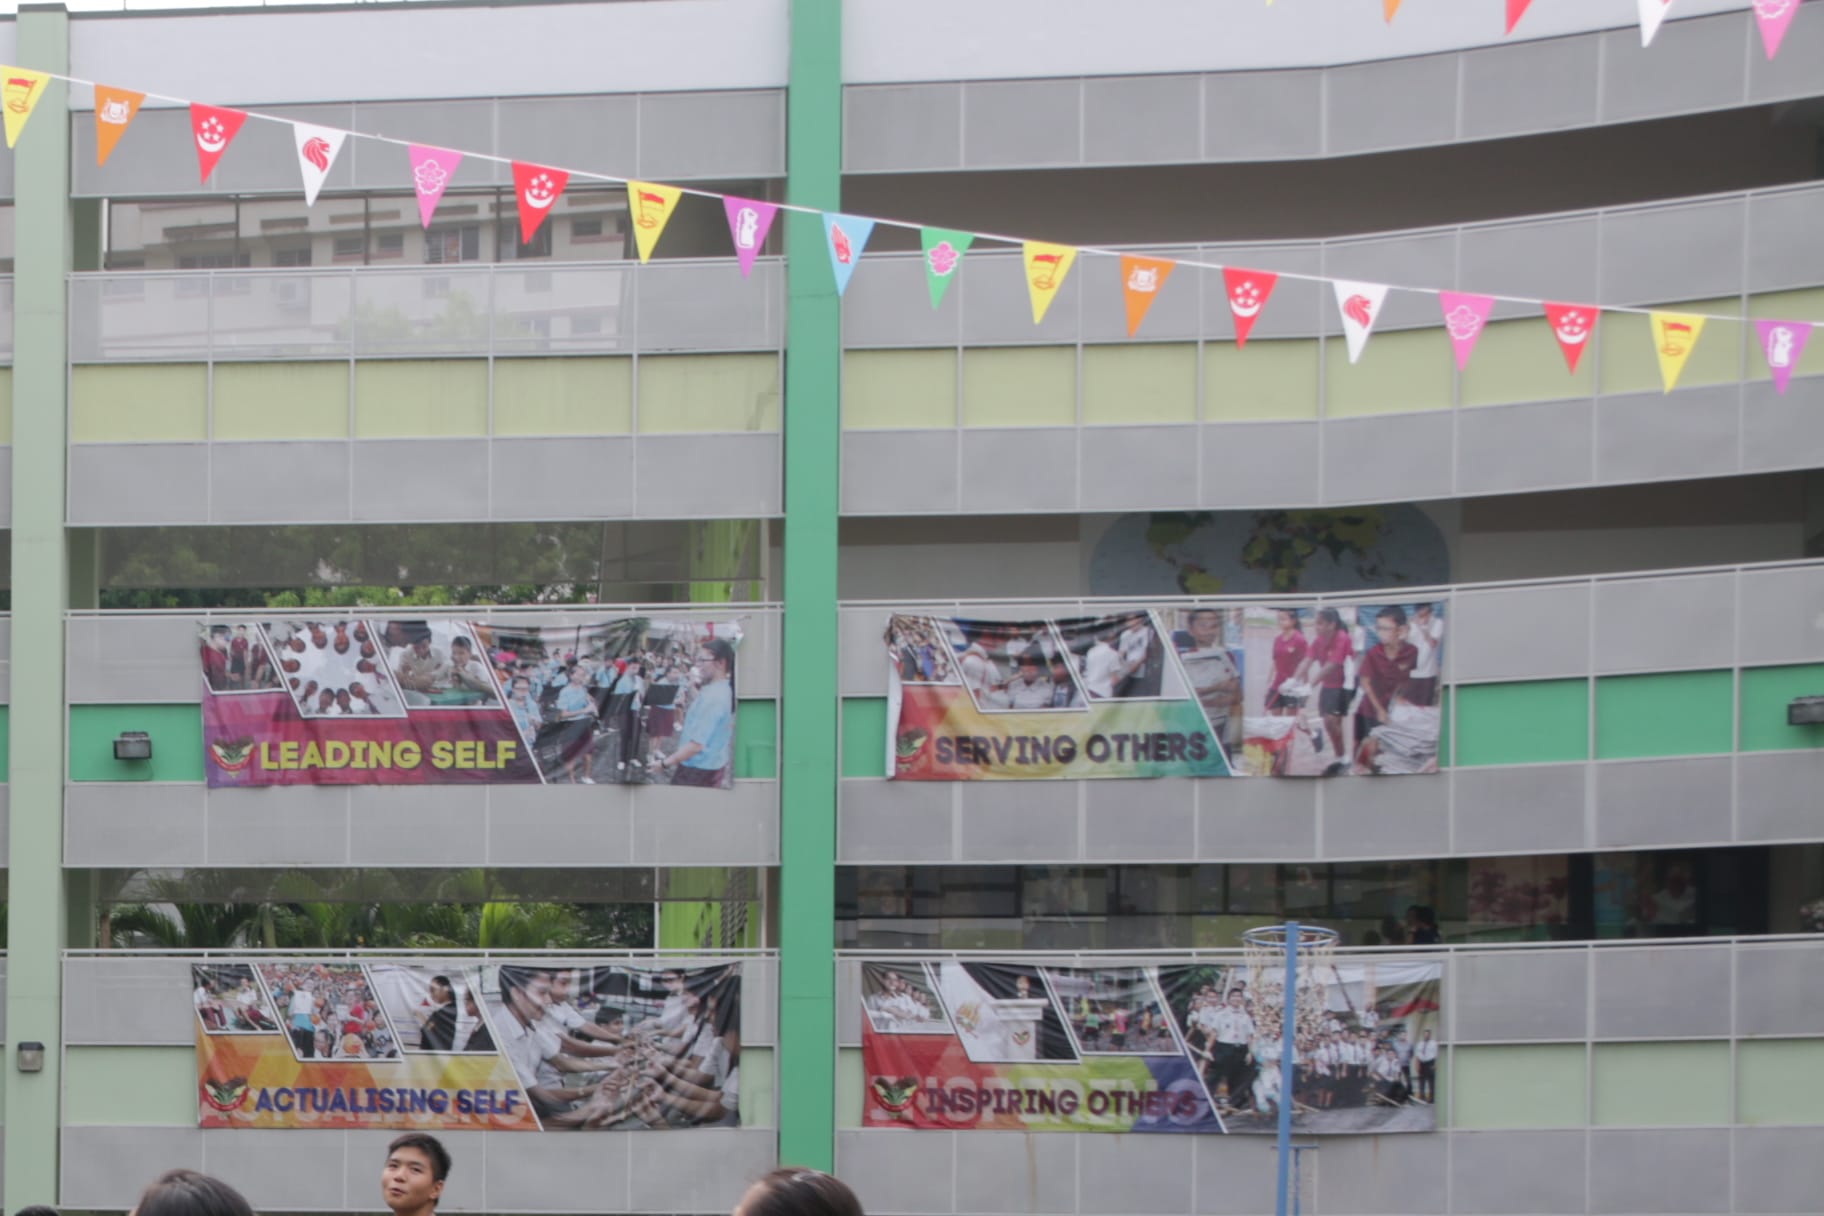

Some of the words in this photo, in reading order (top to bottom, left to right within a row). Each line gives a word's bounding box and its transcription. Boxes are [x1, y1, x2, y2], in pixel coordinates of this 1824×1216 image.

[259, 740, 422, 770] LEADING
[431, 740, 517, 769] SELF
[934, 734, 1077, 766] SERVING
[1085, 731, 1210, 764] OTHERS
[254, 1087, 448, 1114] ACTUALISING
[456, 1089, 520, 1114] SELF
[925, 1088, 1078, 1116] INSPIRING
[1086, 1089, 1200, 1117] OTHERS
